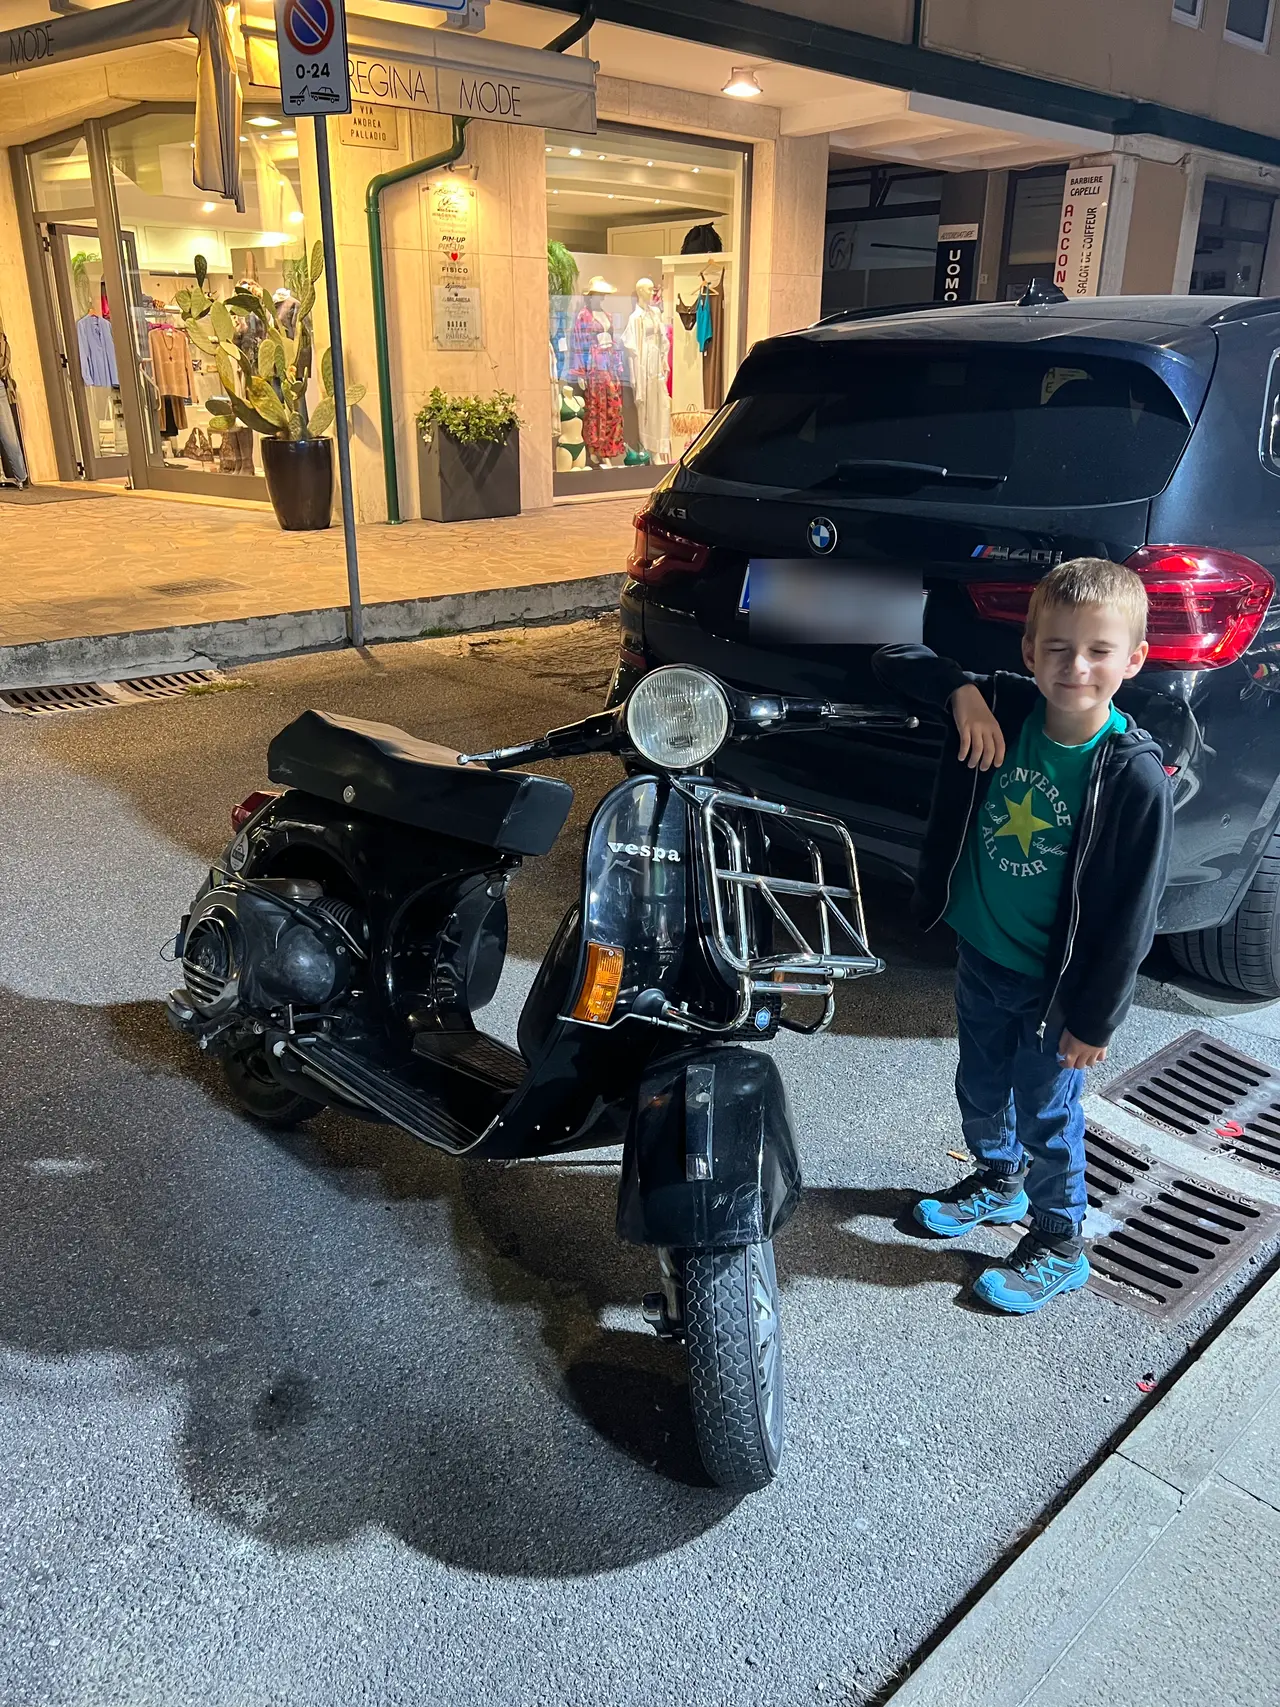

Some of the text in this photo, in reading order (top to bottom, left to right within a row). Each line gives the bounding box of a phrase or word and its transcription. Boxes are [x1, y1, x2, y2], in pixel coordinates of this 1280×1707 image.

[9, 24, 54, 66] MODE
[295, 62, 330, 80] 0-24
[347, 59, 521, 117] REGINA MODE
[359, 105, 373, 115] VIA
[353, 117, 381, 128] ANDREA
[350, 129, 387, 141] PALLADIO
[1070, 175, 1104, 186] BARBIERE
[1070, 186, 1101, 197] CAPELLI
[1082, 207, 1098, 250] COIFFEUR
[441, 235, 466, 243] PIN-UP
[441, 266, 469, 274] FISICO
[944, 249, 961, 302] UOMO
[1077, 265, 1090, 295] SALON
[667, 508, 687, 520] X3
[1000, 767, 1072, 826] CONVERSE
[607, 841, 681, 862] vespa
[982, 825, 1048, 877] ALL STAR
